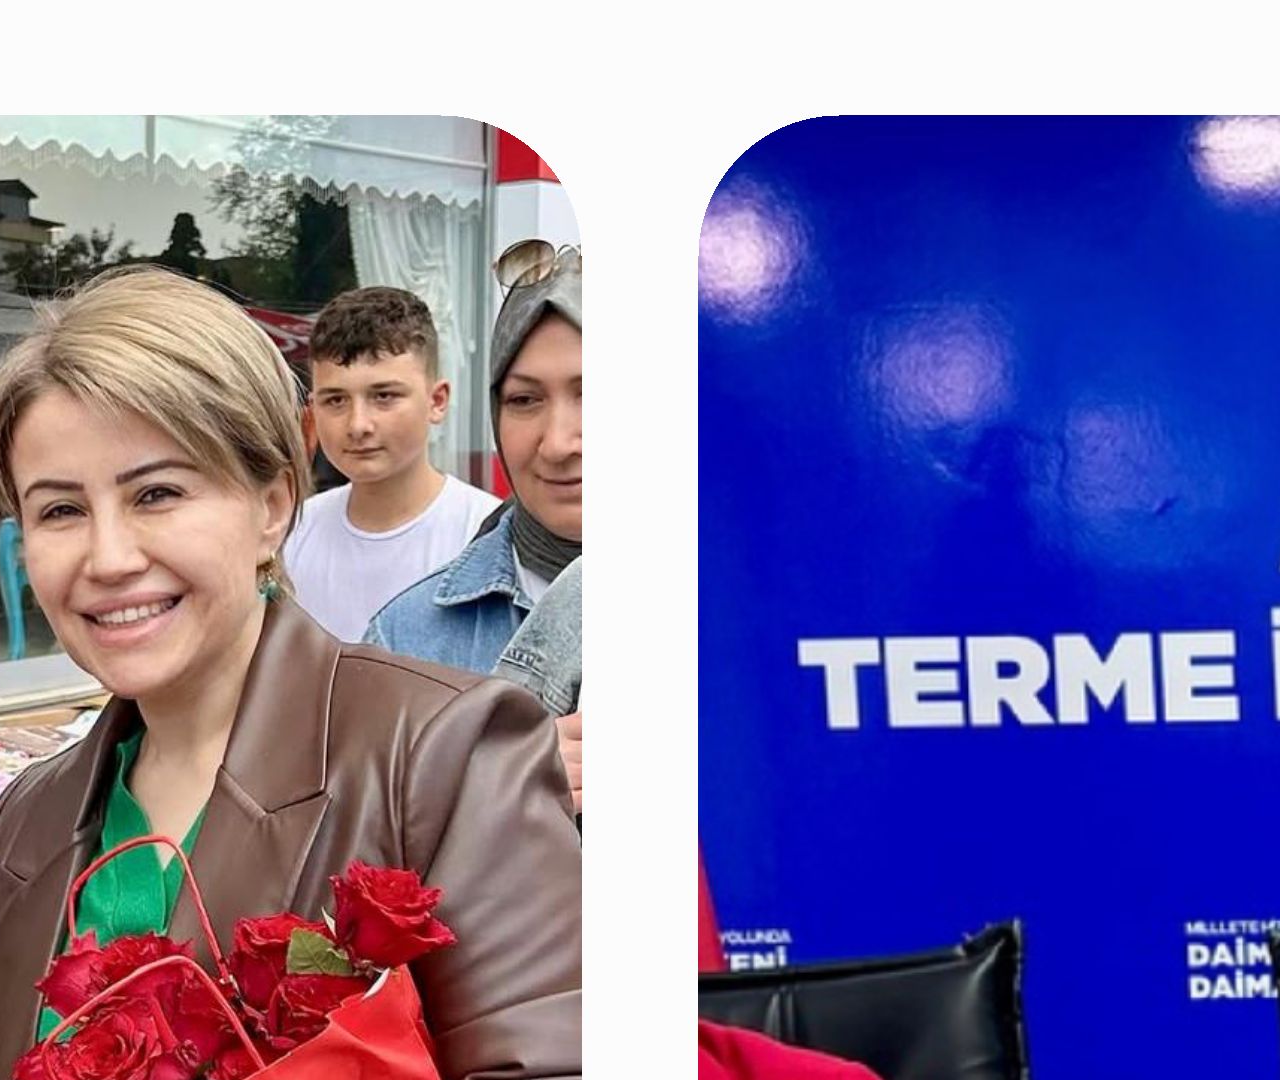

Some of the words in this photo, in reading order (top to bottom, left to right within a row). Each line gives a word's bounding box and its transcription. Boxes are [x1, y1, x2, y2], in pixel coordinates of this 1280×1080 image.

[797, 630, 1240, 729] TERME
[723, 946, 787, 971] ENİ
[1187, 937, 1271, 967] DAİM
